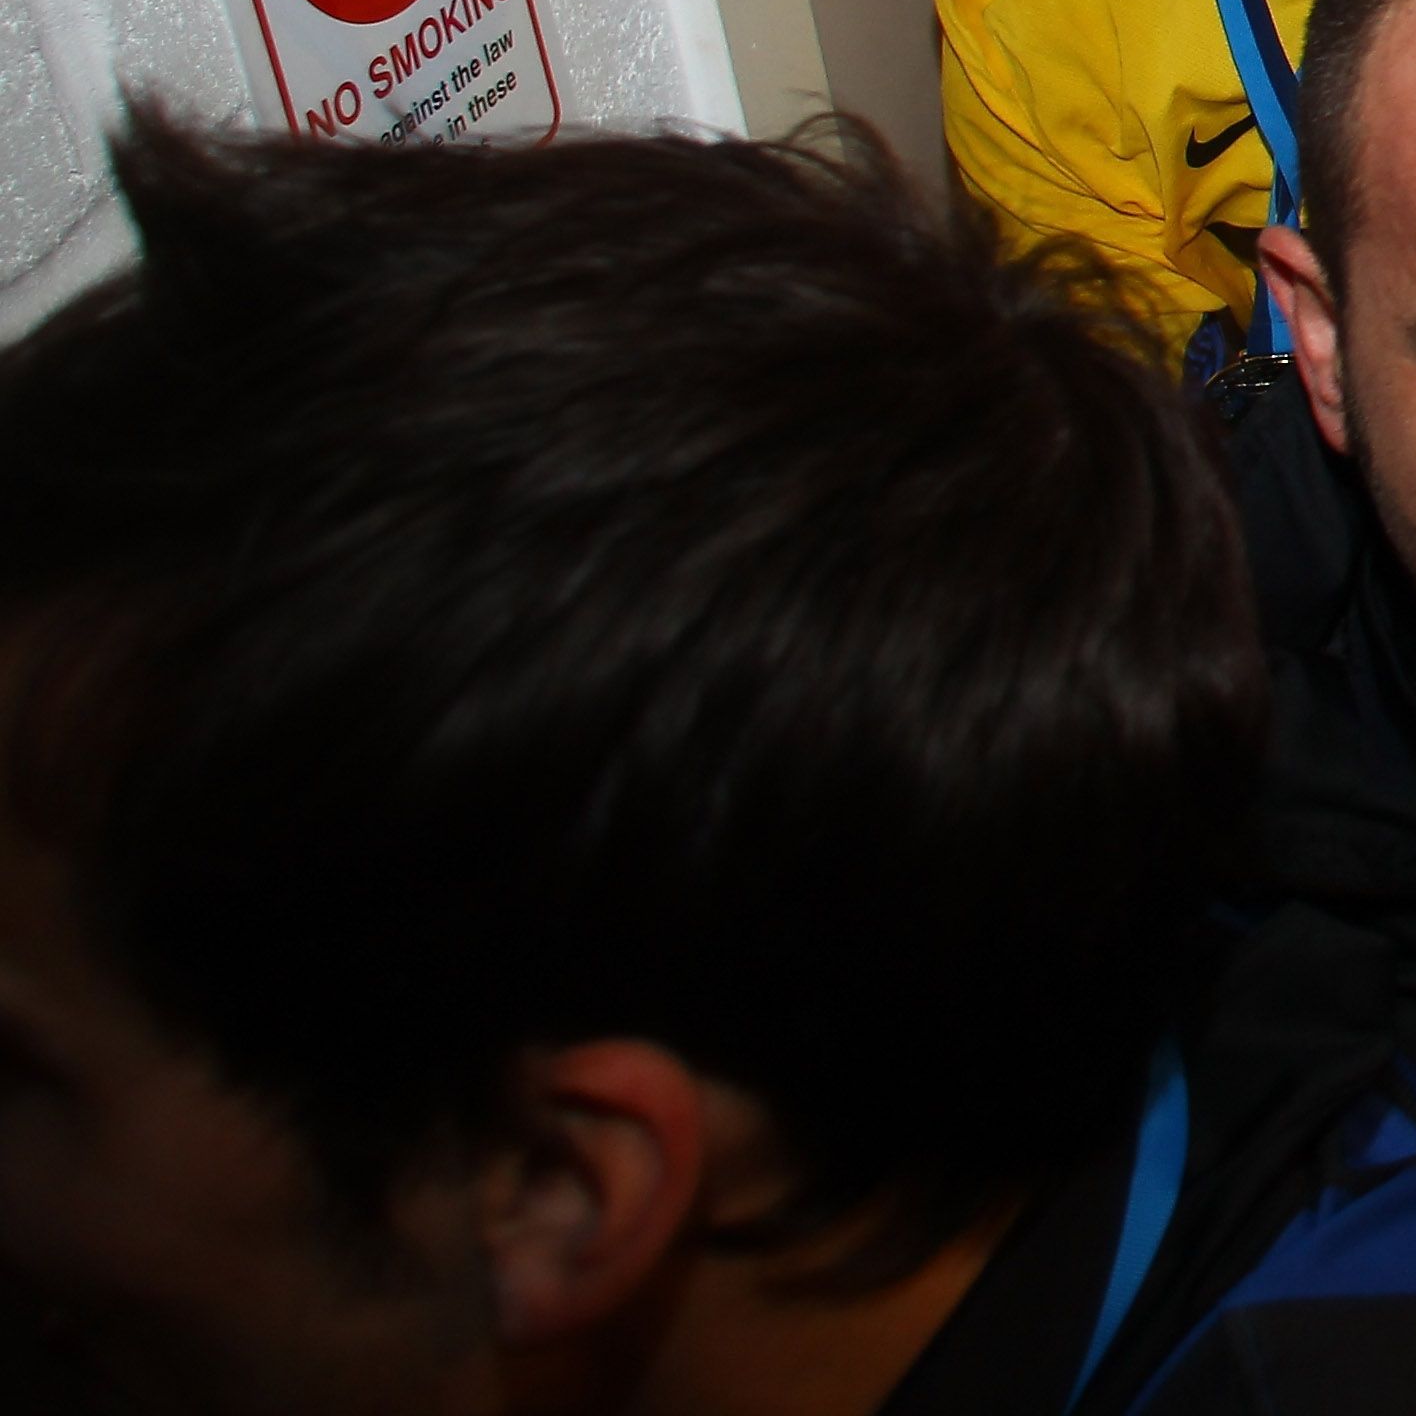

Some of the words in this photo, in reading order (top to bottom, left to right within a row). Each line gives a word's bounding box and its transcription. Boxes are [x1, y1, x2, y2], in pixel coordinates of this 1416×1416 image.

[305, 80, 362, 138] NO
[380, 80, 452, 147] against
[451, 55, 481, 94] the
[483, 29, 515, 67] law
[447, 112, 467, 141] in
[467, 70, 518, 122] these
